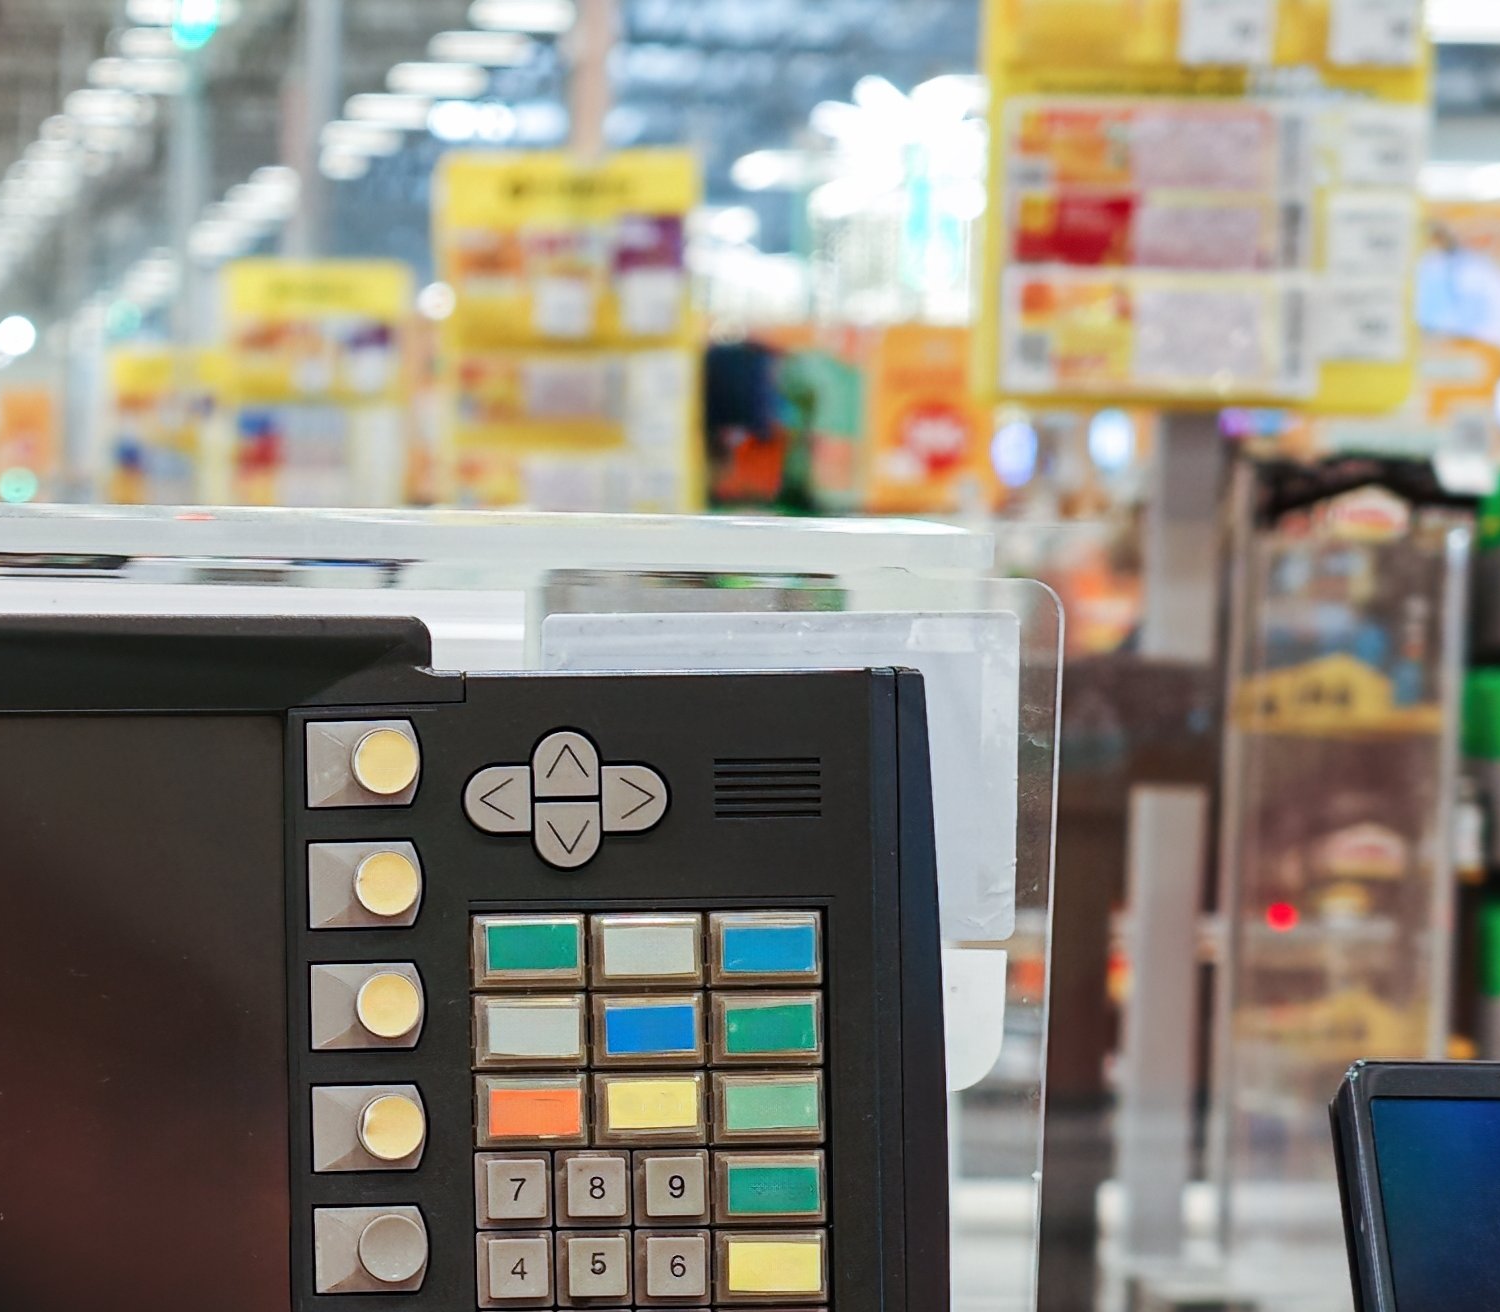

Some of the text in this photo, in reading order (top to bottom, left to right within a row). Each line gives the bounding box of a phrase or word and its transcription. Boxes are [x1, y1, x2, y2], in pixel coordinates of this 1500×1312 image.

[509, 1174, 686, 1202] 7 8 9
[510, 1252, 687, 1281] 4 5 6
